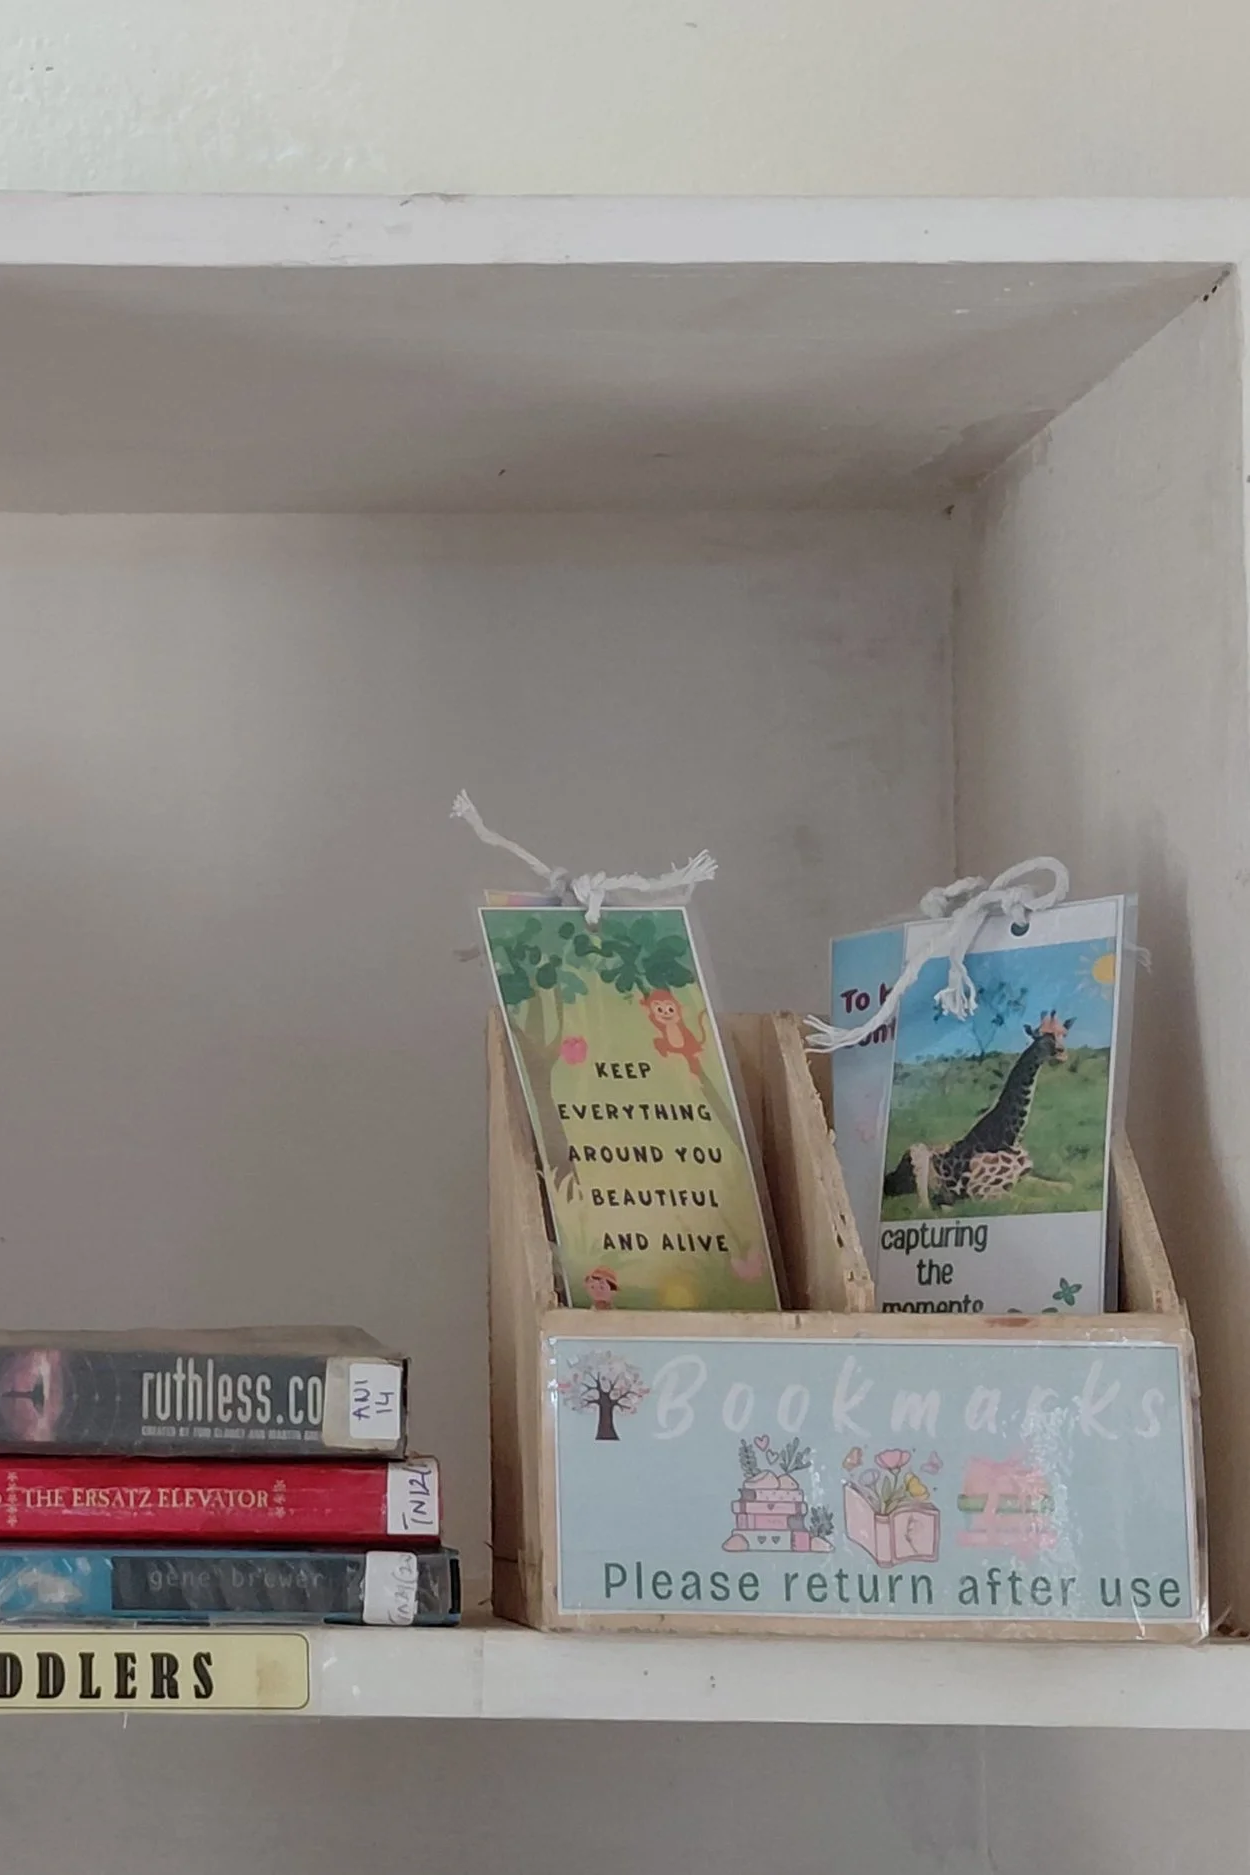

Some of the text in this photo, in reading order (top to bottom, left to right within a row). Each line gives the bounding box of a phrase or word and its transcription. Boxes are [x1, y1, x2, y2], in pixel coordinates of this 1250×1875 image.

[840, 988, 871, 1014] To
[595, 1062, 651, 1080] KEEP
[558, 1103, 713, 1122] EVERYTHING
[567, 1144, 723, 1164] AROUND YOU
[591, 1188, 719, 1208] BEAUTIFUL
[602, 1233, 729, 1253] AND ALIVE
[881, 1221, 989, 1255] capturing
[916, 1259, 954, 1286] the
[141, 1356, 323, 1425] ruthless.co
[651, 1353, 1168, 1440] Bookmarks
[24, 1487, 269, 1509] THE ERSATZ ELEVATOR
[149, 1566, 325, 1592] gene brewer
[602, 1561, 1182, 1609] Please return after use
